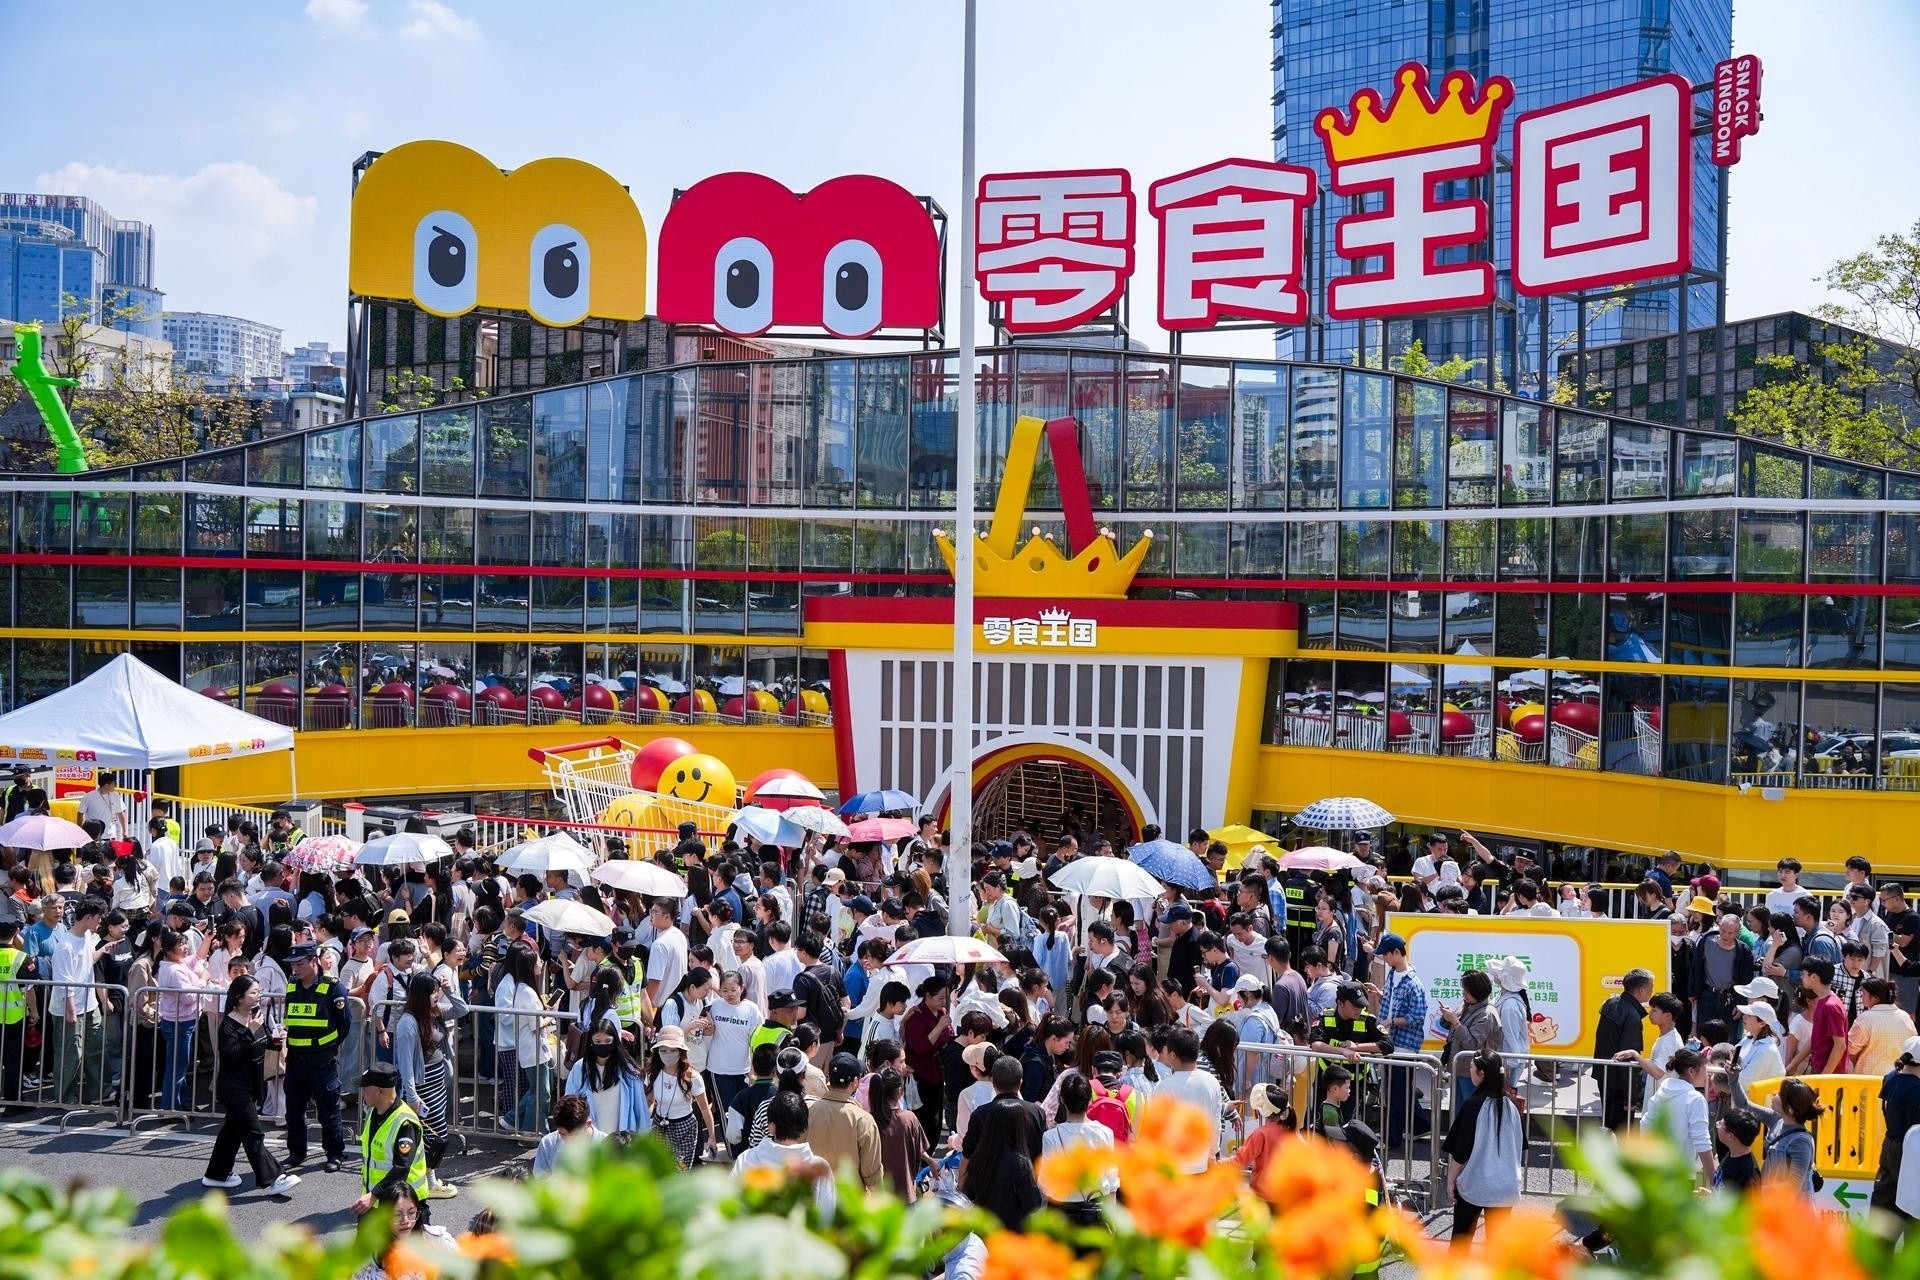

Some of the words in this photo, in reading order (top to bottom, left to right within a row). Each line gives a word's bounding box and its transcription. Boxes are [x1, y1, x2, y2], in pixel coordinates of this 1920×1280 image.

[1716, 63, 1733, 158] KINGDOM
[1735, 59, 1750, 128] SNACK
[976, 74, 1692, 332] 零食王国
[983, 617, 1097, 647] 零食王国
[291, 1004, 313, 1014] 执勤
[1430, 988, 1465, 999] 世茂环
